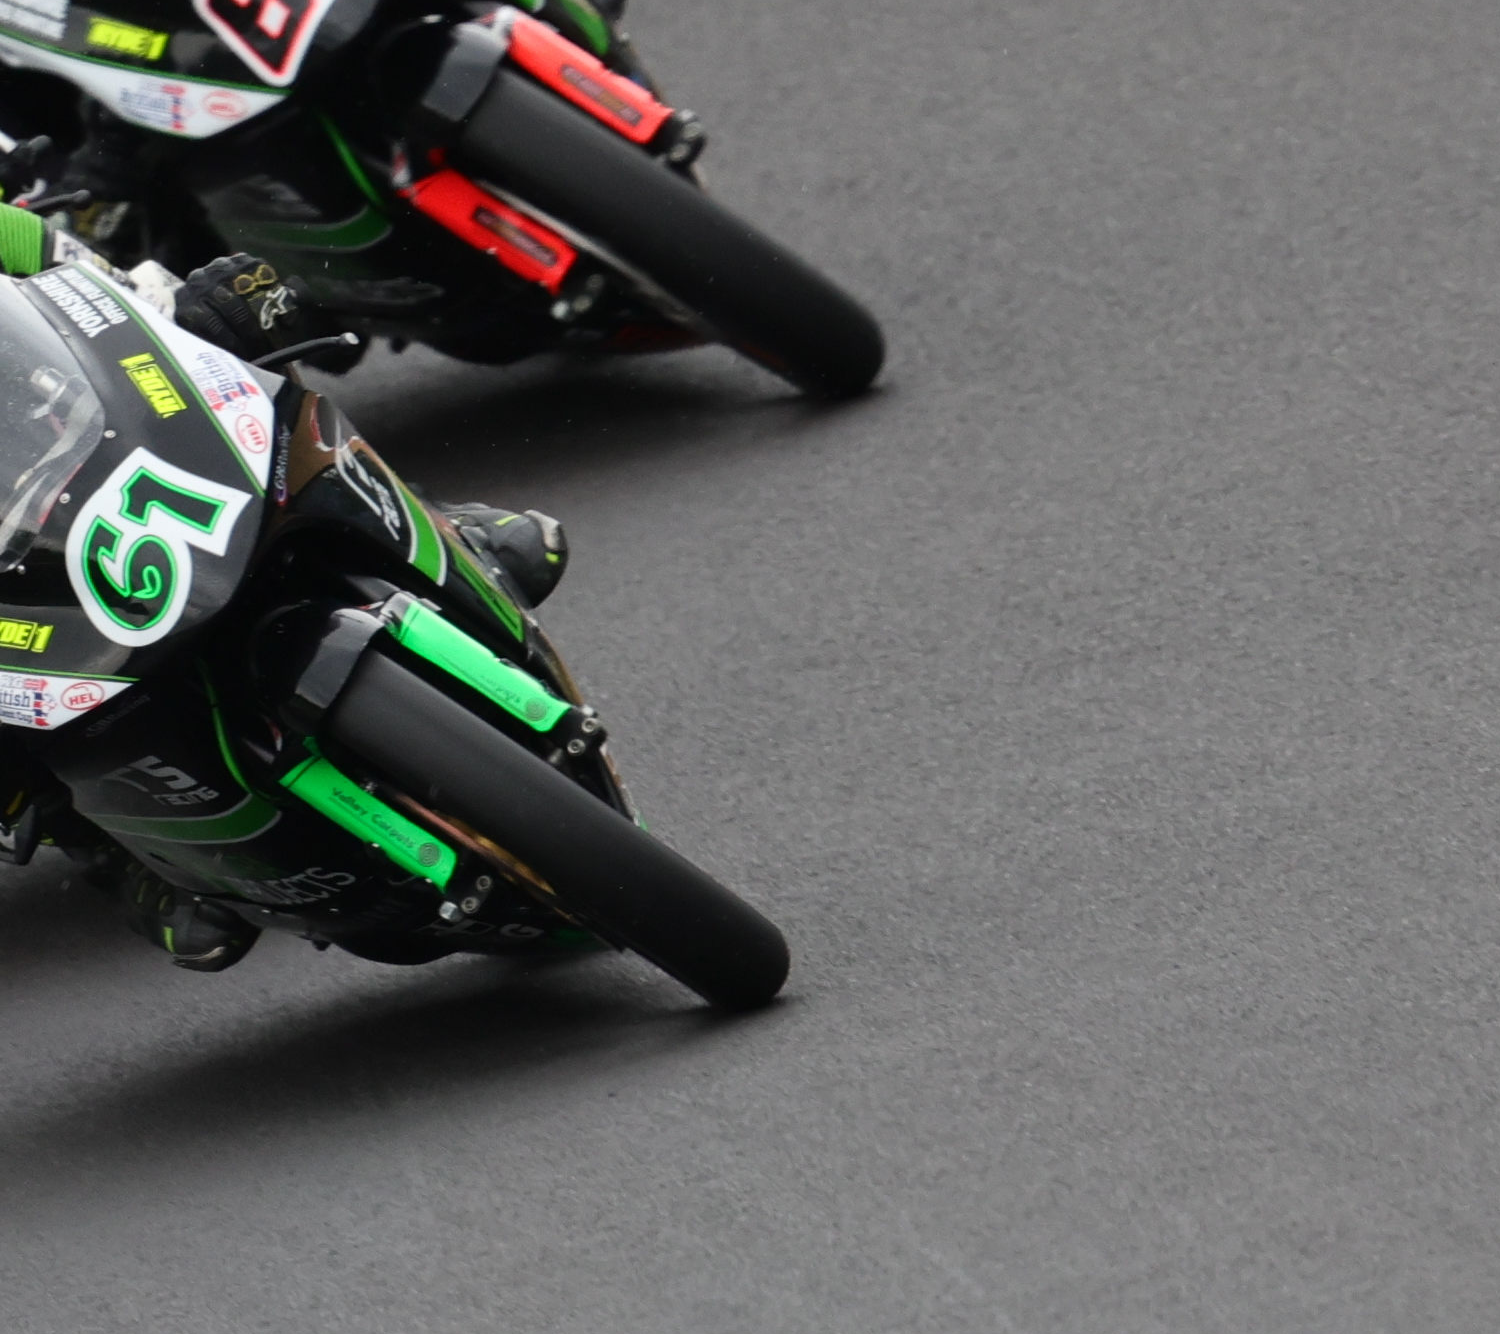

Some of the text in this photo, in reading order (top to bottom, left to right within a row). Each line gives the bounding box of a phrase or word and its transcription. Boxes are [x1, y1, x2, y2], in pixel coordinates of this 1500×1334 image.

[31, 273, 110, 338] YORKSHIRE
[81, 466, 228, 632] 61
[69, 692, 98, 707] HEL
